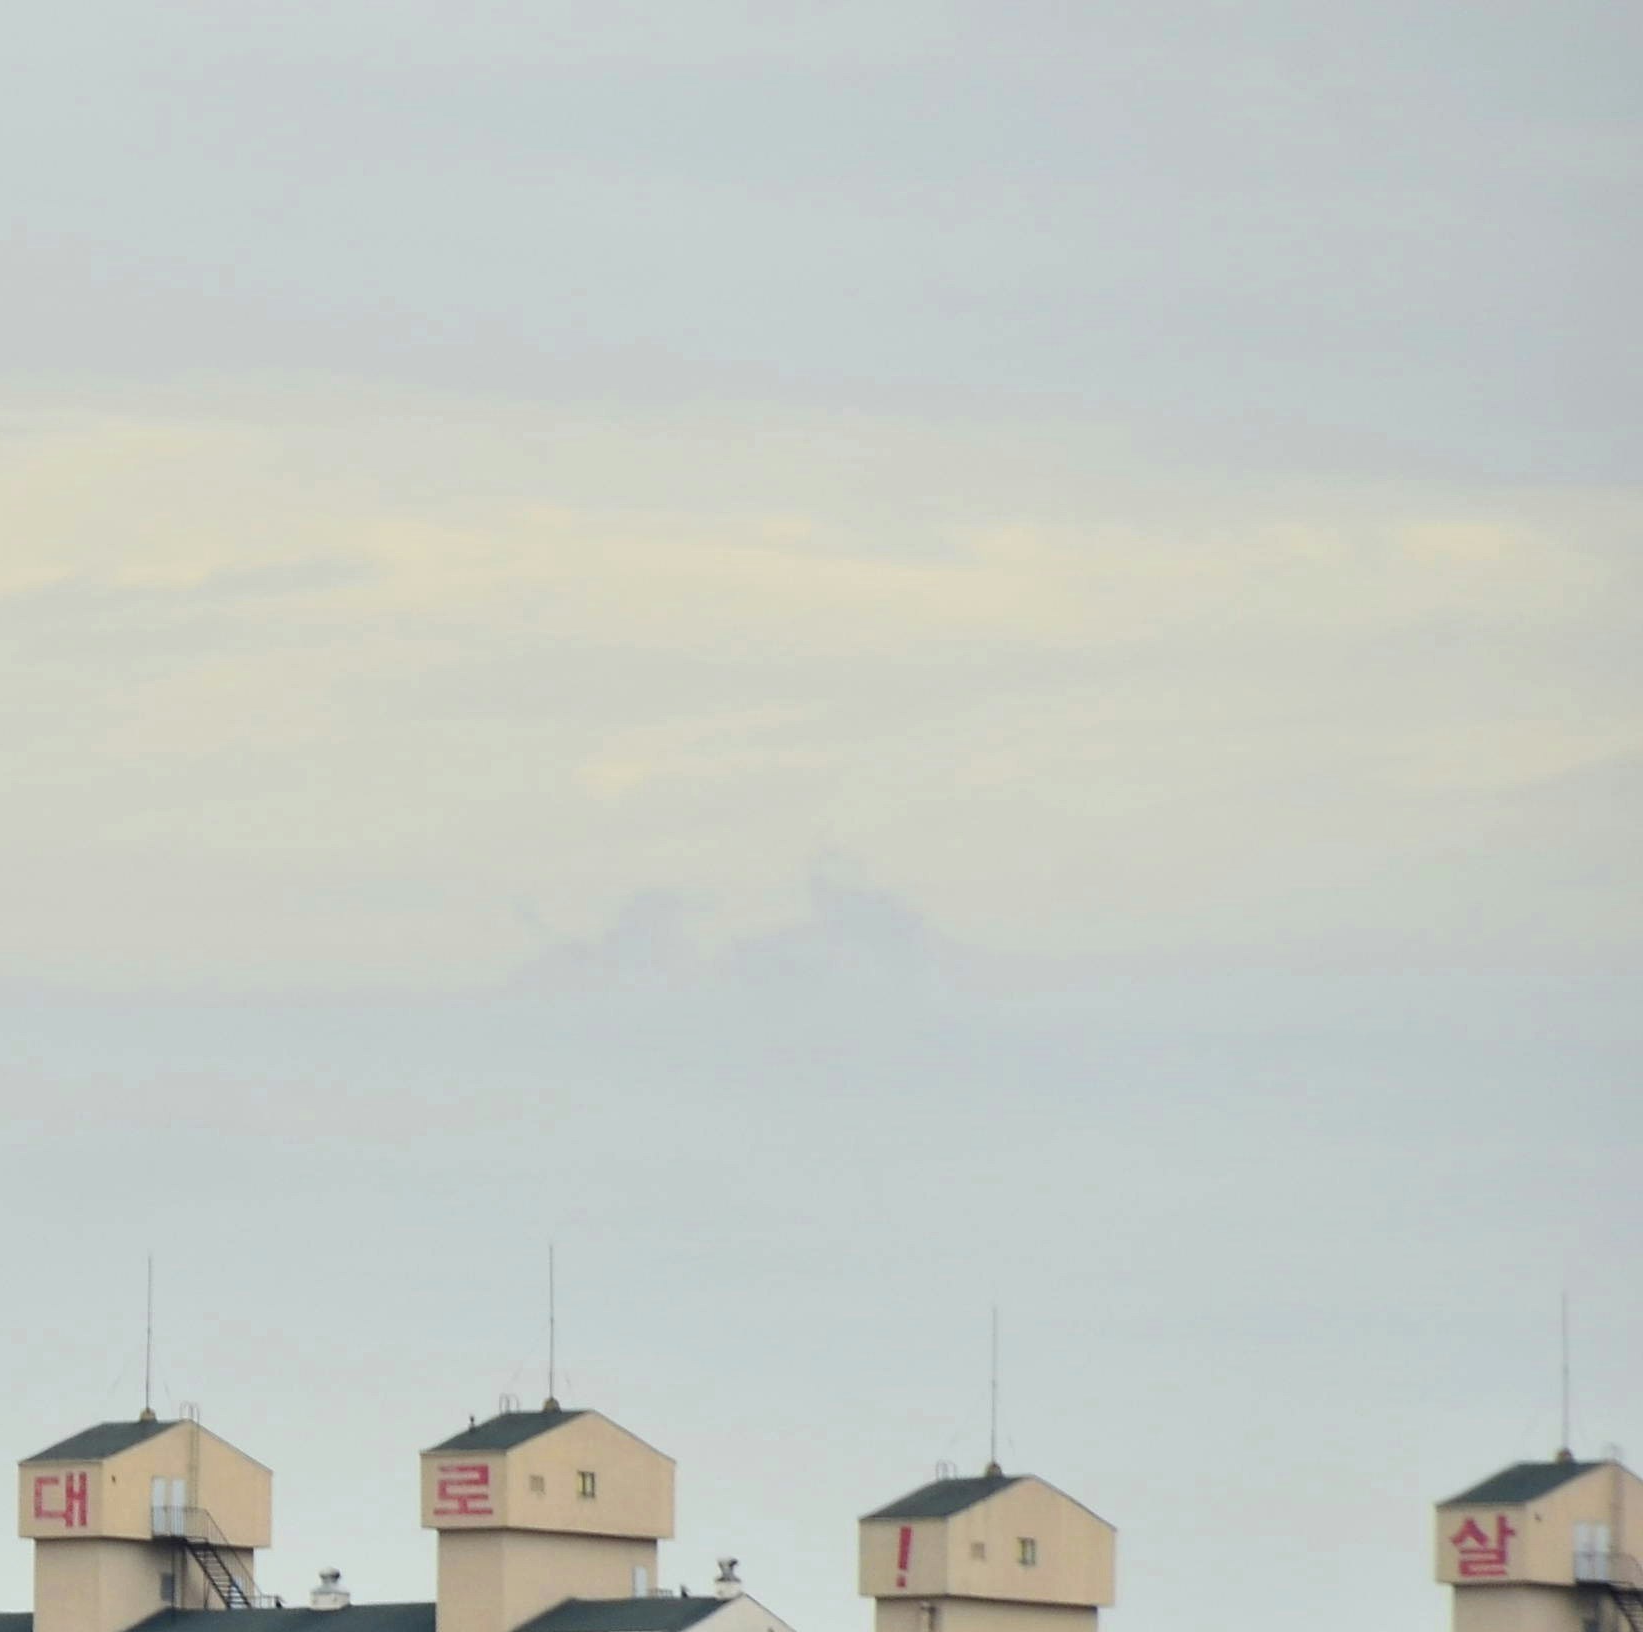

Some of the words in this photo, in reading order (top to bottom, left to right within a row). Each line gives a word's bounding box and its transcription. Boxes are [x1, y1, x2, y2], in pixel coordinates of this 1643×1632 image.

[33, 1471, 87, 1528] 대
[433, 1463, 493, 1515] 로
[1451, 1514, 1516, 1577] 살
